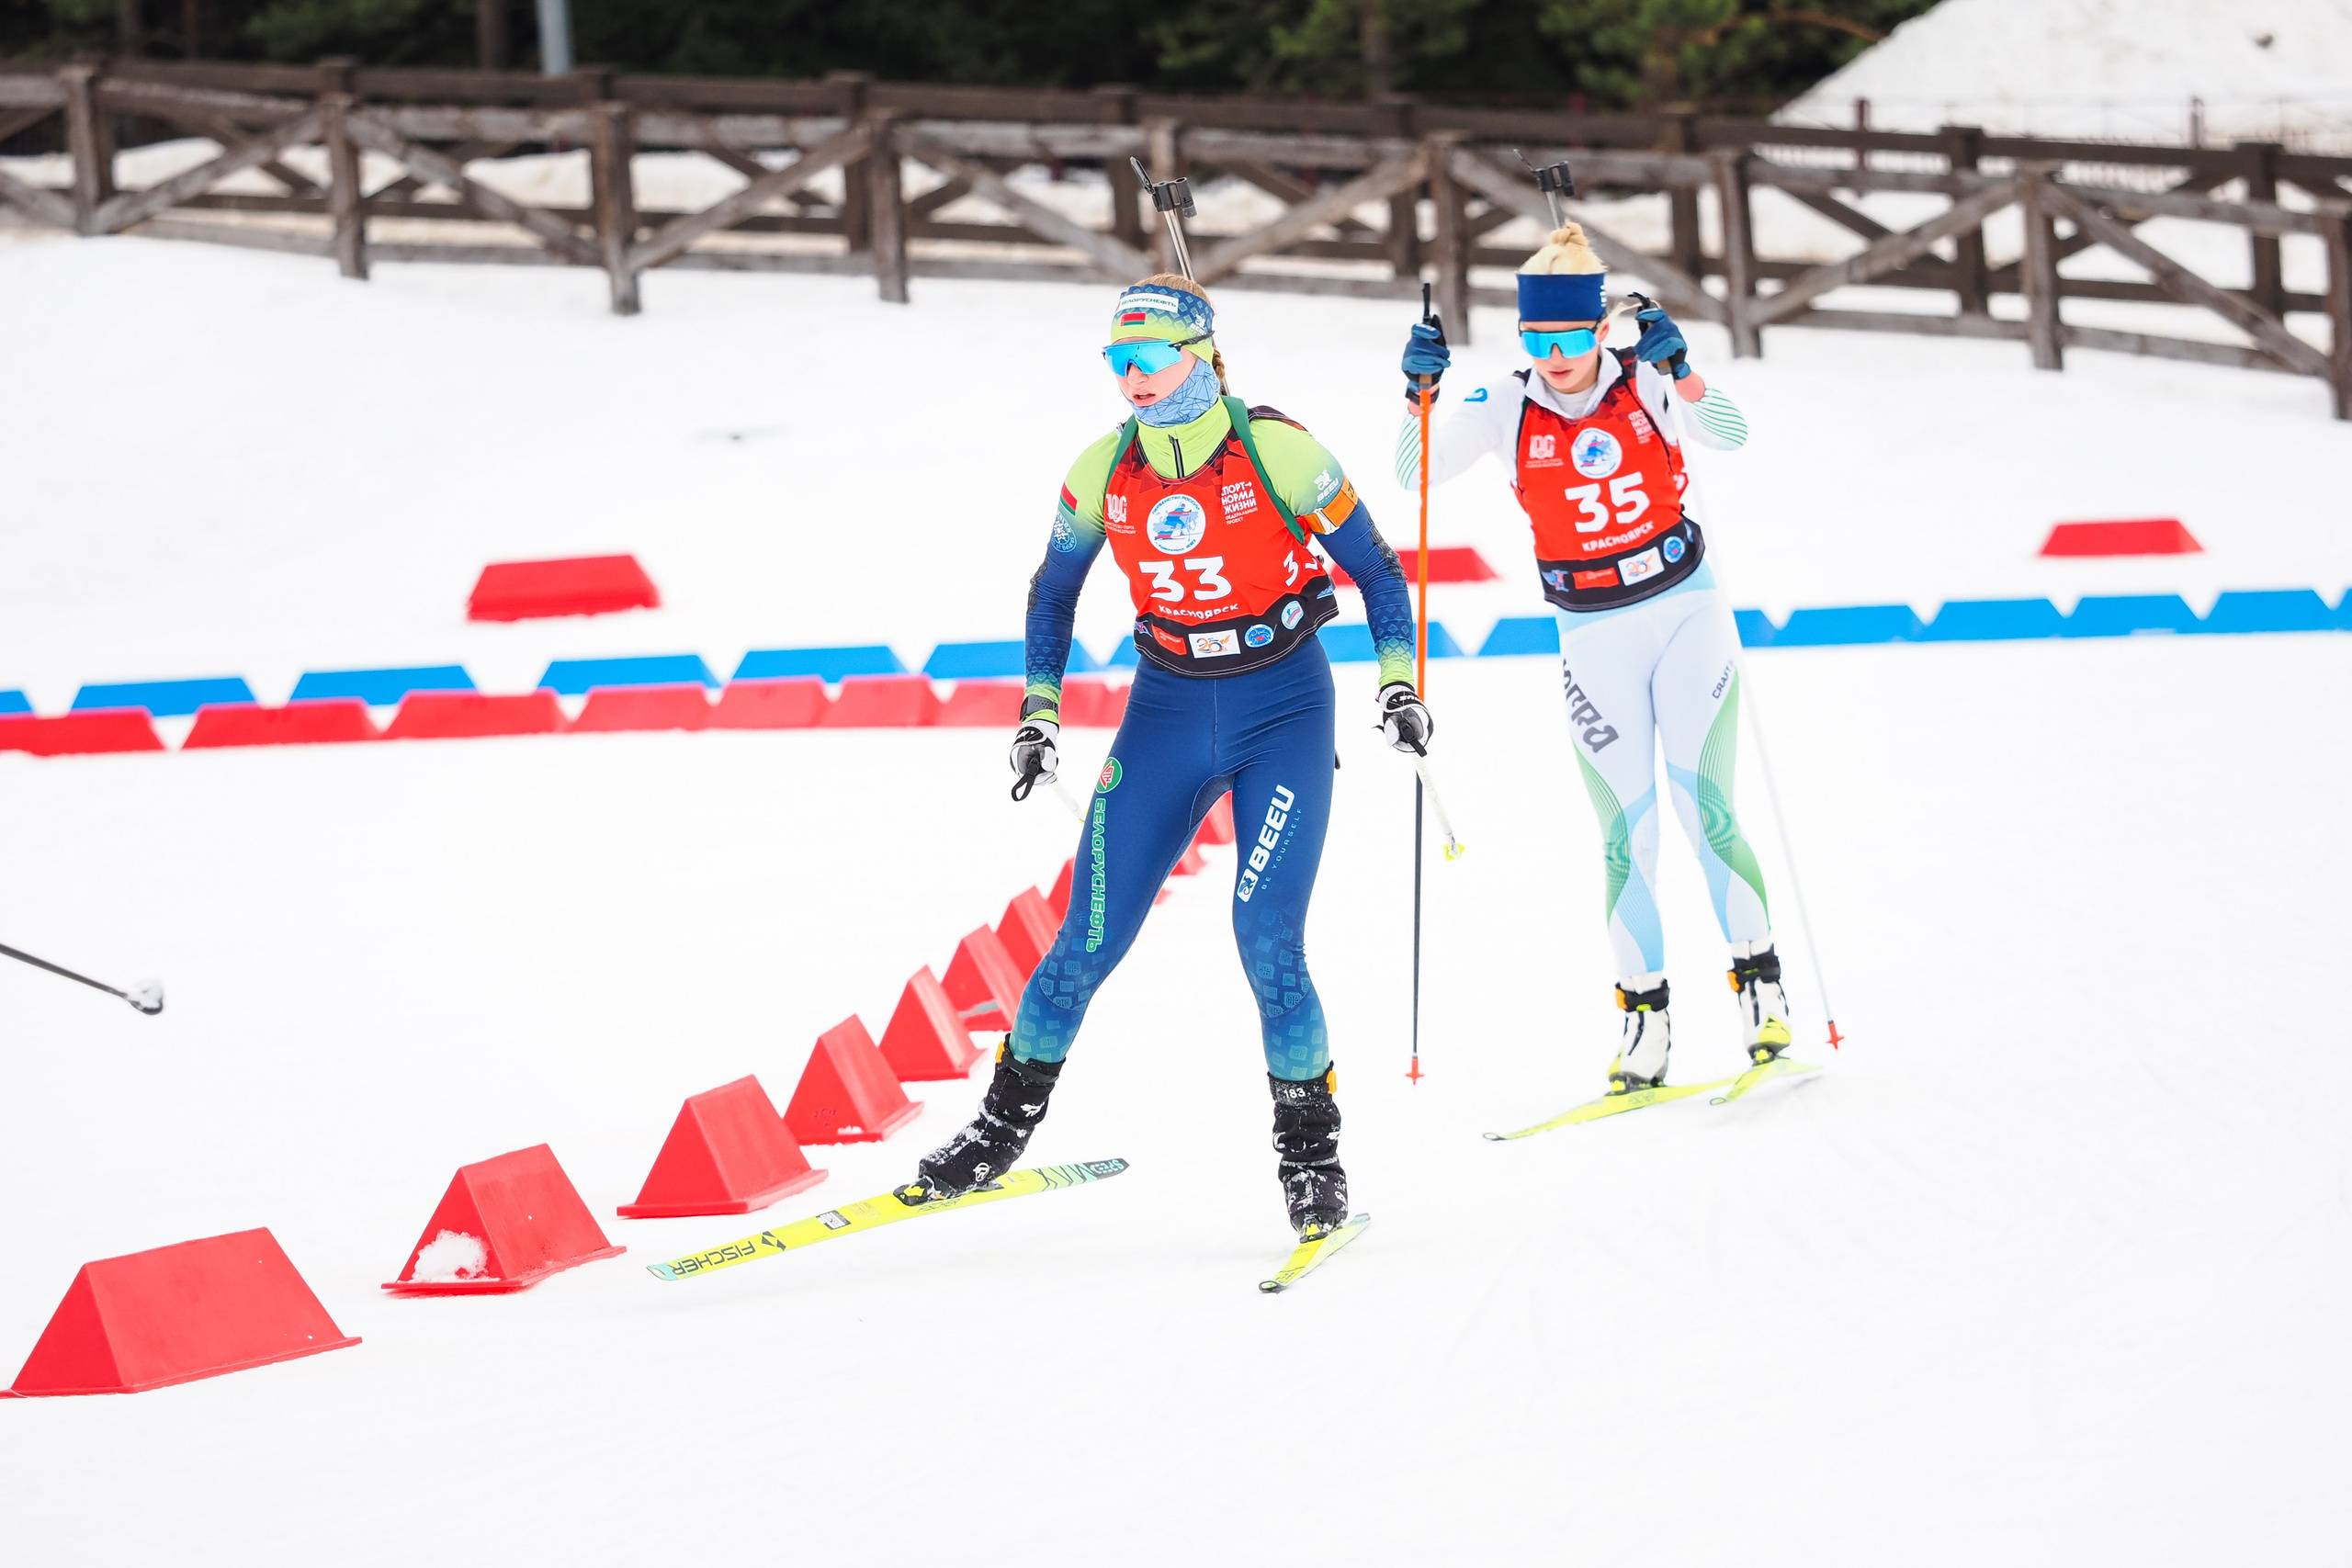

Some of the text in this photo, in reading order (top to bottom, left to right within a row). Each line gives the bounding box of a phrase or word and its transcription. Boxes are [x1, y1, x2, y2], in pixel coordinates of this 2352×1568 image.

[1221, 481, 1246, 496] ПОРТ
[1221, 489, 1255, 505] НОРМА
[1565, 471, 1650, 533] 35
[1224, 498, 1257, 514] ЖИЗНИ
[1581, 521, 1655, 552] КРАСНОЯРСК
[1138, 556, 1232, 602] 33
[1159, 604, 1238, 619] КРАСНОЯРСК
[1249, 784, 1295, 873] BEEU
[1261, 808, 1302, 890] BE YOURSELF
[1086, 797, 1106, 953] БЕЛОРУСНЕФТЬ
[1283, 1088, 1306, 1099] 183
[671, 1240, 756, 1275] FISCHER
